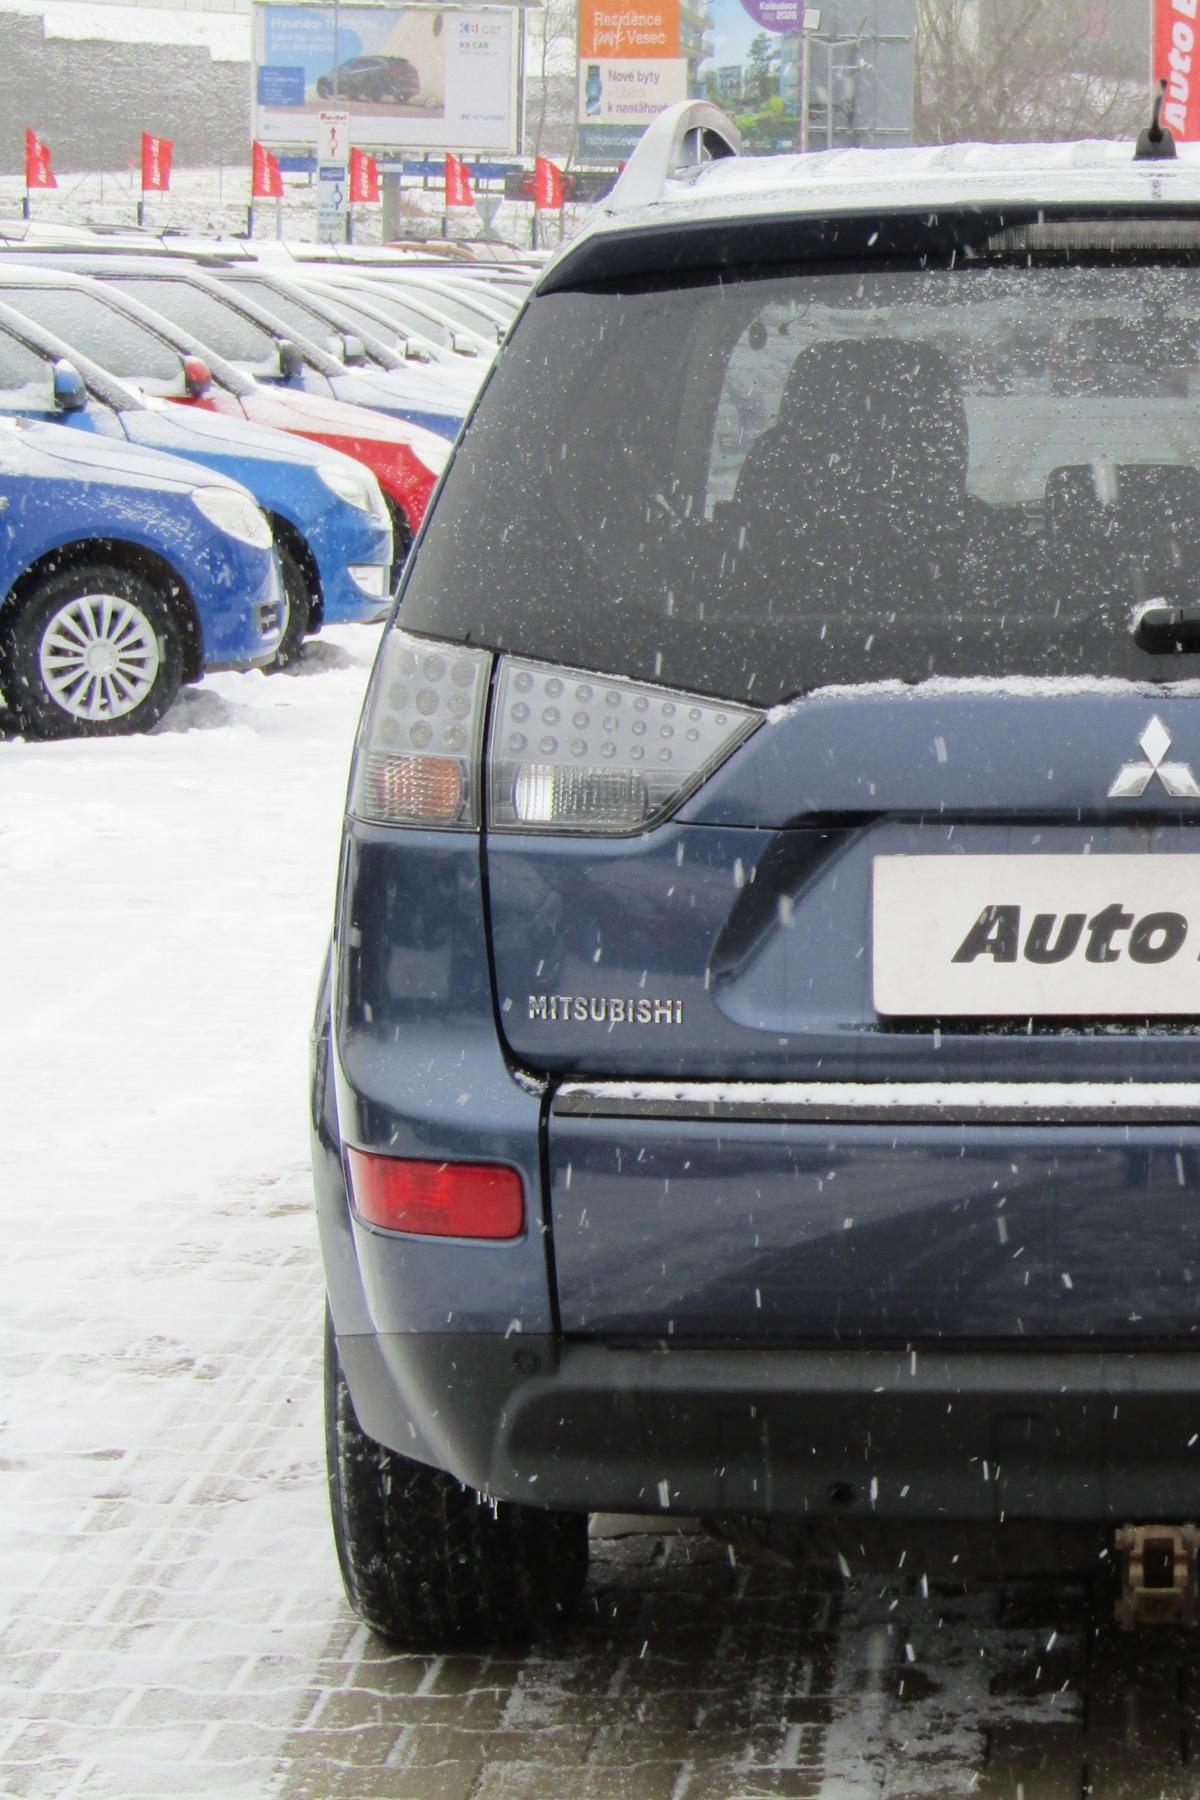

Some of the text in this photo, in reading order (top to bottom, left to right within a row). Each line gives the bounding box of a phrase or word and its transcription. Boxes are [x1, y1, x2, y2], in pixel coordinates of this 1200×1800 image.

[594, 11, 662, 26] Rezidence
[626, 31, 666, 44] Vesec
[608, 70, 660, 84] Nové byty
[1165, 21, 1194, 135] Auto
[608, 102, 614, 113] k
[951, 903, 1187, 964] Auto
[528, 995, 683, 1024] MITSUBISHI
